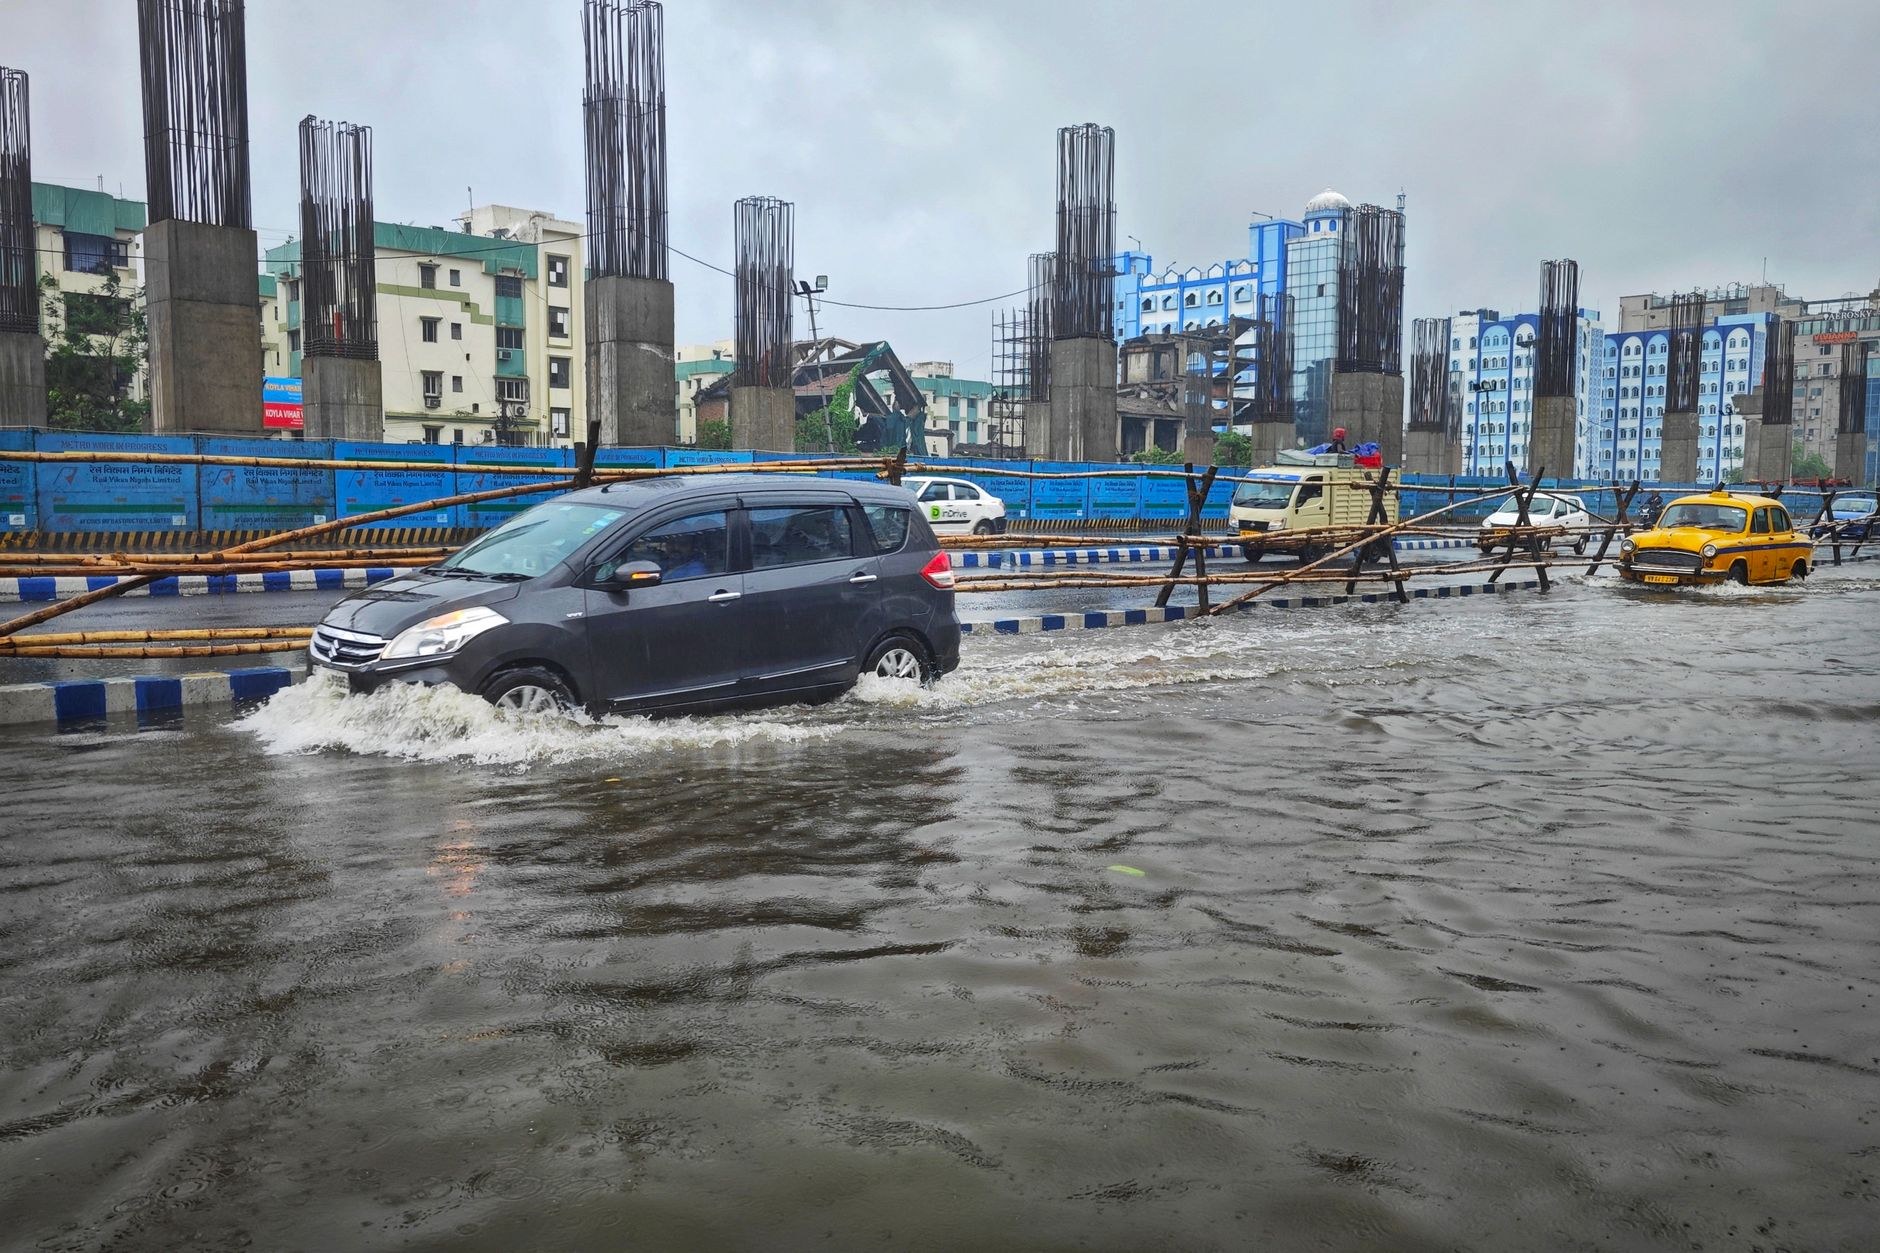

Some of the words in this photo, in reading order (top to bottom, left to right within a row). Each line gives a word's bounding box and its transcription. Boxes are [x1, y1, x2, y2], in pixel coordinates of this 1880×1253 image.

[1828, 310, 1872, 320] AEROSKY
[265, 409, 283, 418] KOYLA
[283, 410, 301, 419] VIHAR
[61, 440, 91, 449] METRO
[92, 441, 115, 450] WORK
[125, 442, 168, 451] PROGRESS
[942, 510, 968, 518] inDrive
